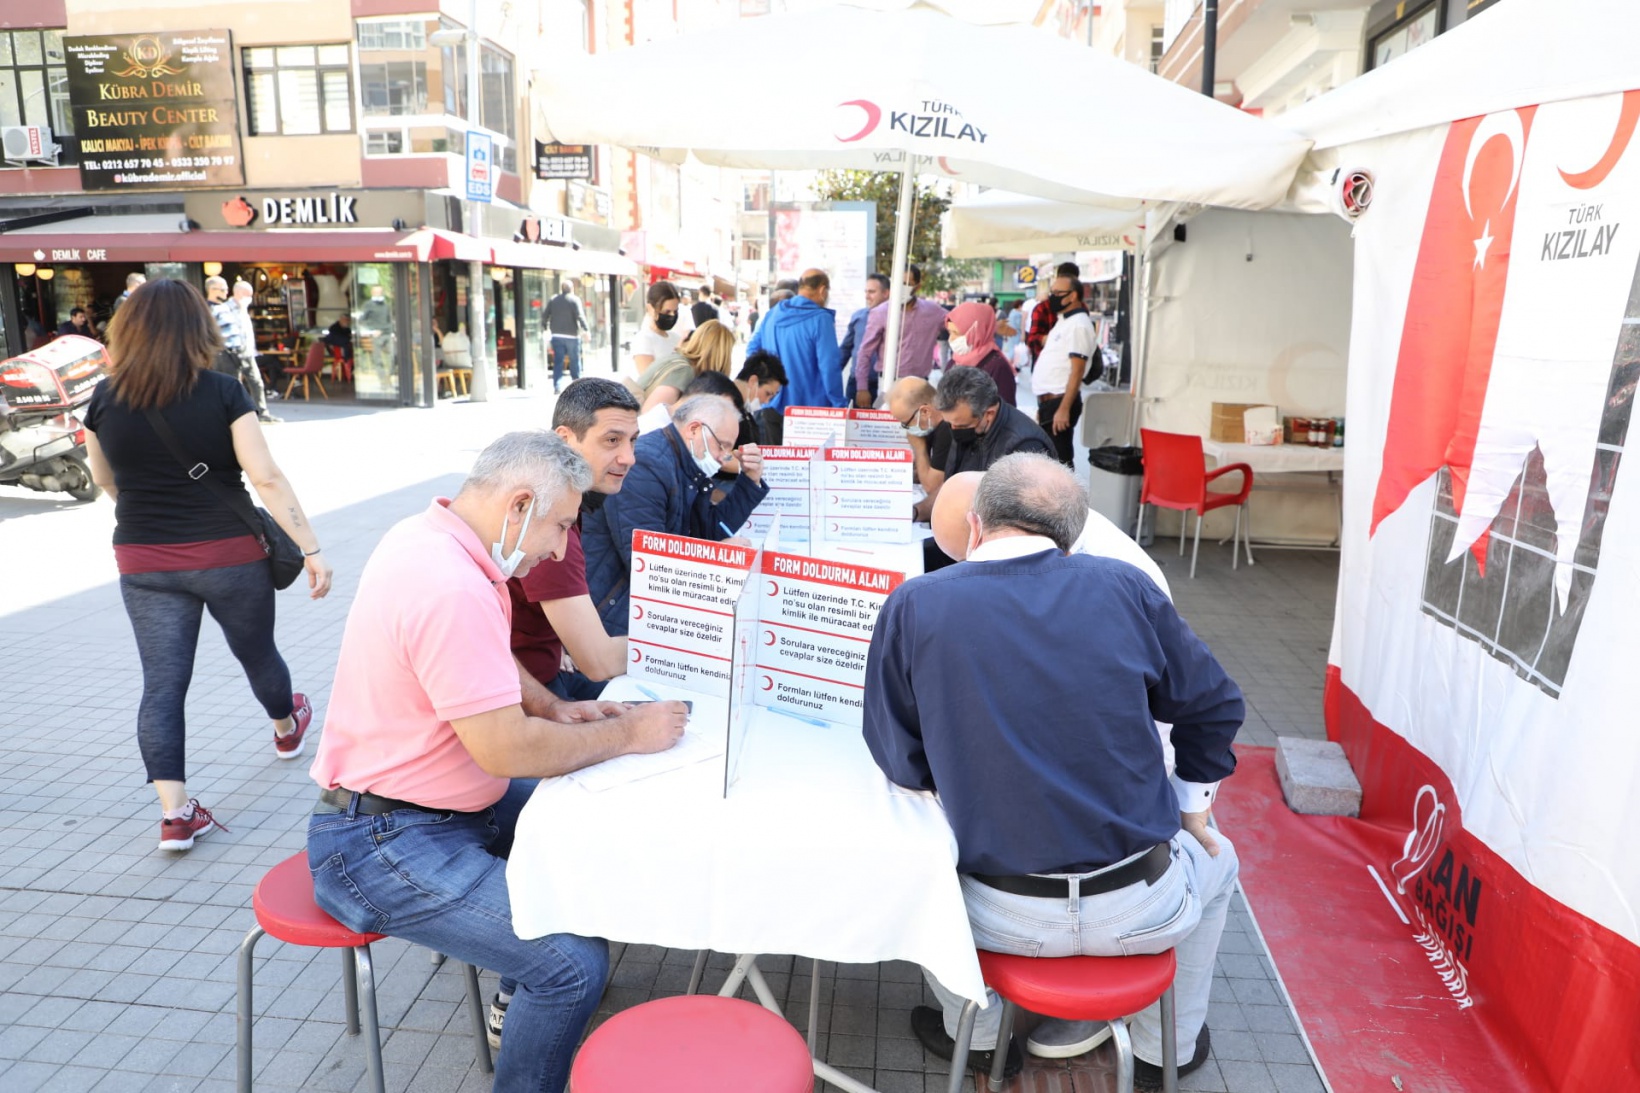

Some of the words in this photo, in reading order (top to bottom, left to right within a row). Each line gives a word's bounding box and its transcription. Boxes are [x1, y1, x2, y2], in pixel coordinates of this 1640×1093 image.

[86, 109, 148, 127] BEAUTY
[152, 106, 219, 125] CENTER
[921, 99, 963, 119] TÜRK
[890, 111, 988, 144] KIZILAY
[30, 129, 41, 155] VESTEL
[470, 182, 490, 195] EDS
[262, 192, 355, 224] DEMLİK
[1569, 203, 1603, 225] TÜRK
[1541, 223, 1620, 261] KIZILAY
[52, 248, 80, 261] DEMLİK
[87, 249, 107, 261] CAFE
[832, 449, 849, 459] FORM
[850, 449, 885, 459] DOLDURMA
[886, 450, 905, 460] ALANI
[642, 535, 667, 552] FORM
[667, 540, 716, 561] DOLDURMA
[717, 547, 746, 566] ALANI
[649, 562, 673, 574] Lütfen
[674, 566, 708, 581] üzerinde
[709, 573, 724, 584] T.C.
[725, 576, 745, 587] Kimli
[773, 557, 801, 575] FORM
[802, 562, 857, 585] DOLDURMA
[858, 570, 890, 590] ALANI
[648, 583, 670, 594] kimlik
[671, 586, 681, 596] ile
[682, 590, 718, 604] müracaat
[719, 596, 736, 606] edin
[670, 577, 687, 587] olan
[688, 581, 715, 592] resimli
[716, 586, 728, 595] bir
[782, 598, 806, 609] no'su
[807, 602, 826, 613] olan
[827, 606, 857, 619] resimli
[858, 610, 871, 621] bir
[783, 587, 810, 599] Lütfen
[811, 592, 849, 606] üzerinde
[850, 598, 867, 609] T.C.
[647, 611, 679, 624] Sorulara
[680, 619, 723, 633] vereceğiniz
[781, 608, 807, 620] kimlik
[808, 611, 819, 622] ile
[820, 615, 861, 631] müracaat
[646, 622, 678, 635] cevaplar
[679, 628, 695, 638] size
[696, 632, 723, 643] özeldir
[779, 648, 815, 661] cevaplar
[816, 655, 834, 665] size
[835, 658, 865, 671] özeldir
[780, 636, 815, 651] Sorulara
[816, 645, 866, 661] vereceğiniz
[644, 665, 687, 681] doldurunuz
[645, 655, 676, 669] Formları
[677, 660, 699, 673] lütfen
[776, 694, 824, 710] doldurunuz
[777, 682, 812, 697] Formları
[813, 689, 838, 702] lütfen
[839, 695, 864, 708] kendi
[1427, 848, 1482, 928] AN
[1415, 875, 1474, 961] BAĞIŞI
